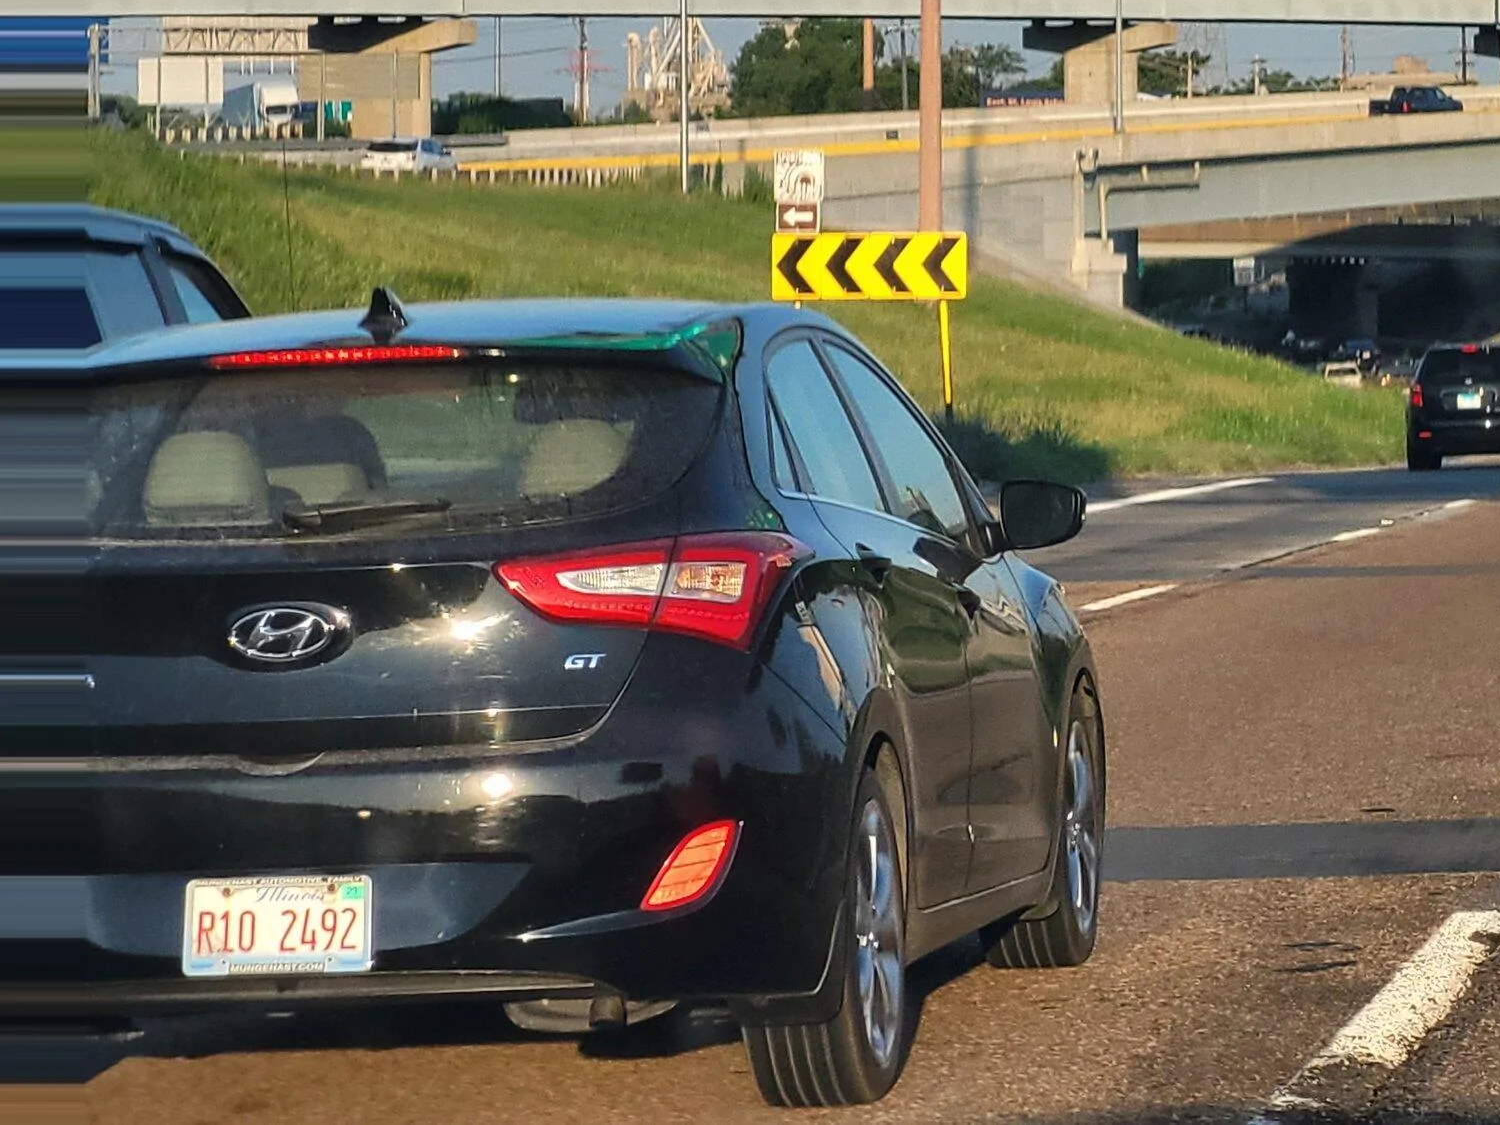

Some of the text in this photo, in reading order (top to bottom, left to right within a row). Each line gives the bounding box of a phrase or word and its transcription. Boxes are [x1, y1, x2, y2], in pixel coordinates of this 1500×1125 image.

[564, 653, 607, 670] GT
[256, 886, 325, 902] Illinois
[196, 907, 358, 955] R10 2492
